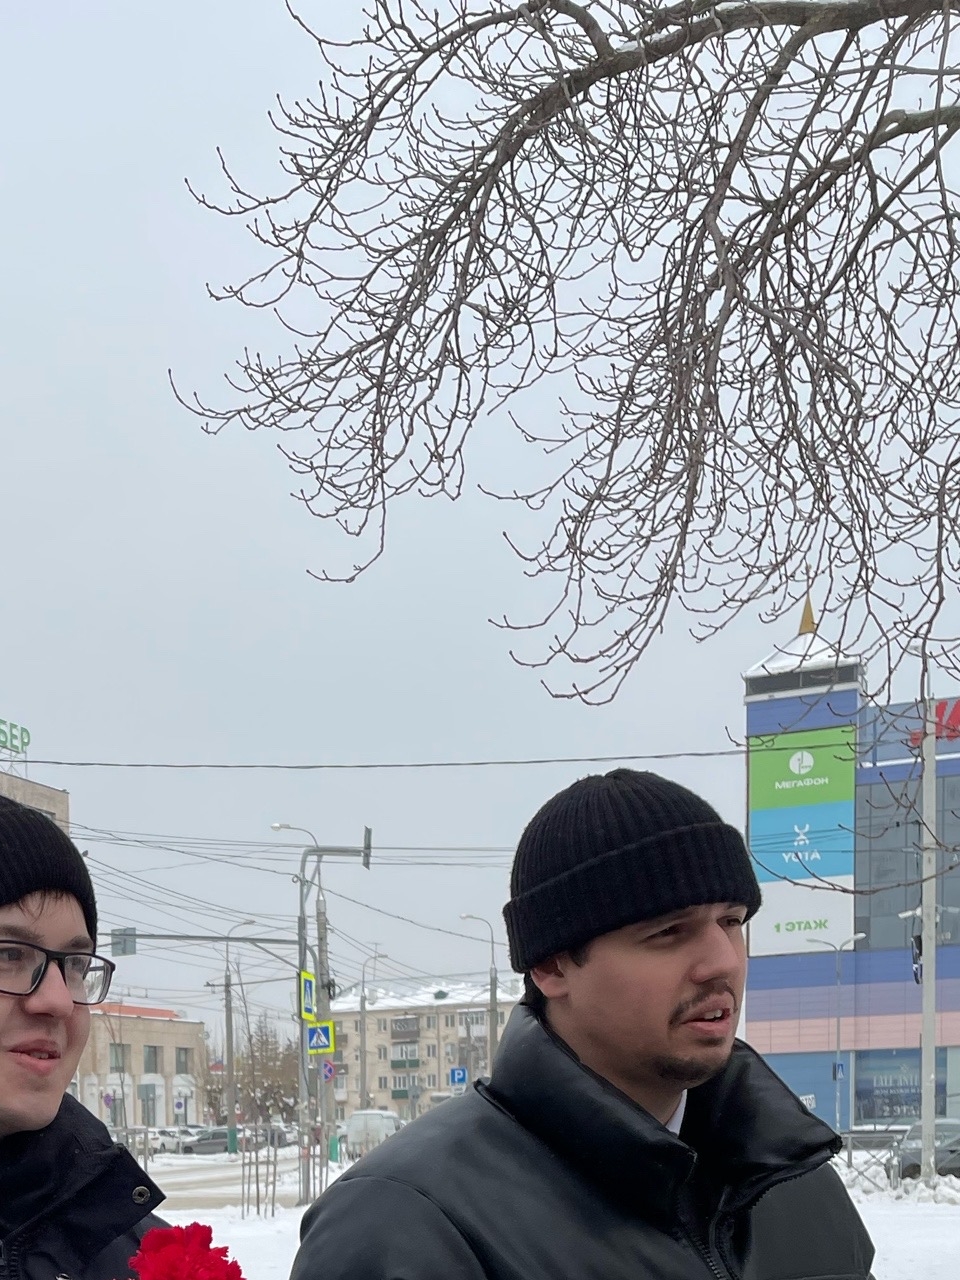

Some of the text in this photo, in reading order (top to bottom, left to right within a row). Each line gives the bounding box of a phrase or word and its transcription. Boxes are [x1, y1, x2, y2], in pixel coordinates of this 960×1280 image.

[774, 777, 829, 790] МЕГАФОН
[782, 852, 821, 864] YOTA
[774, 919, 829, 933] 1 ЭТАЖ
